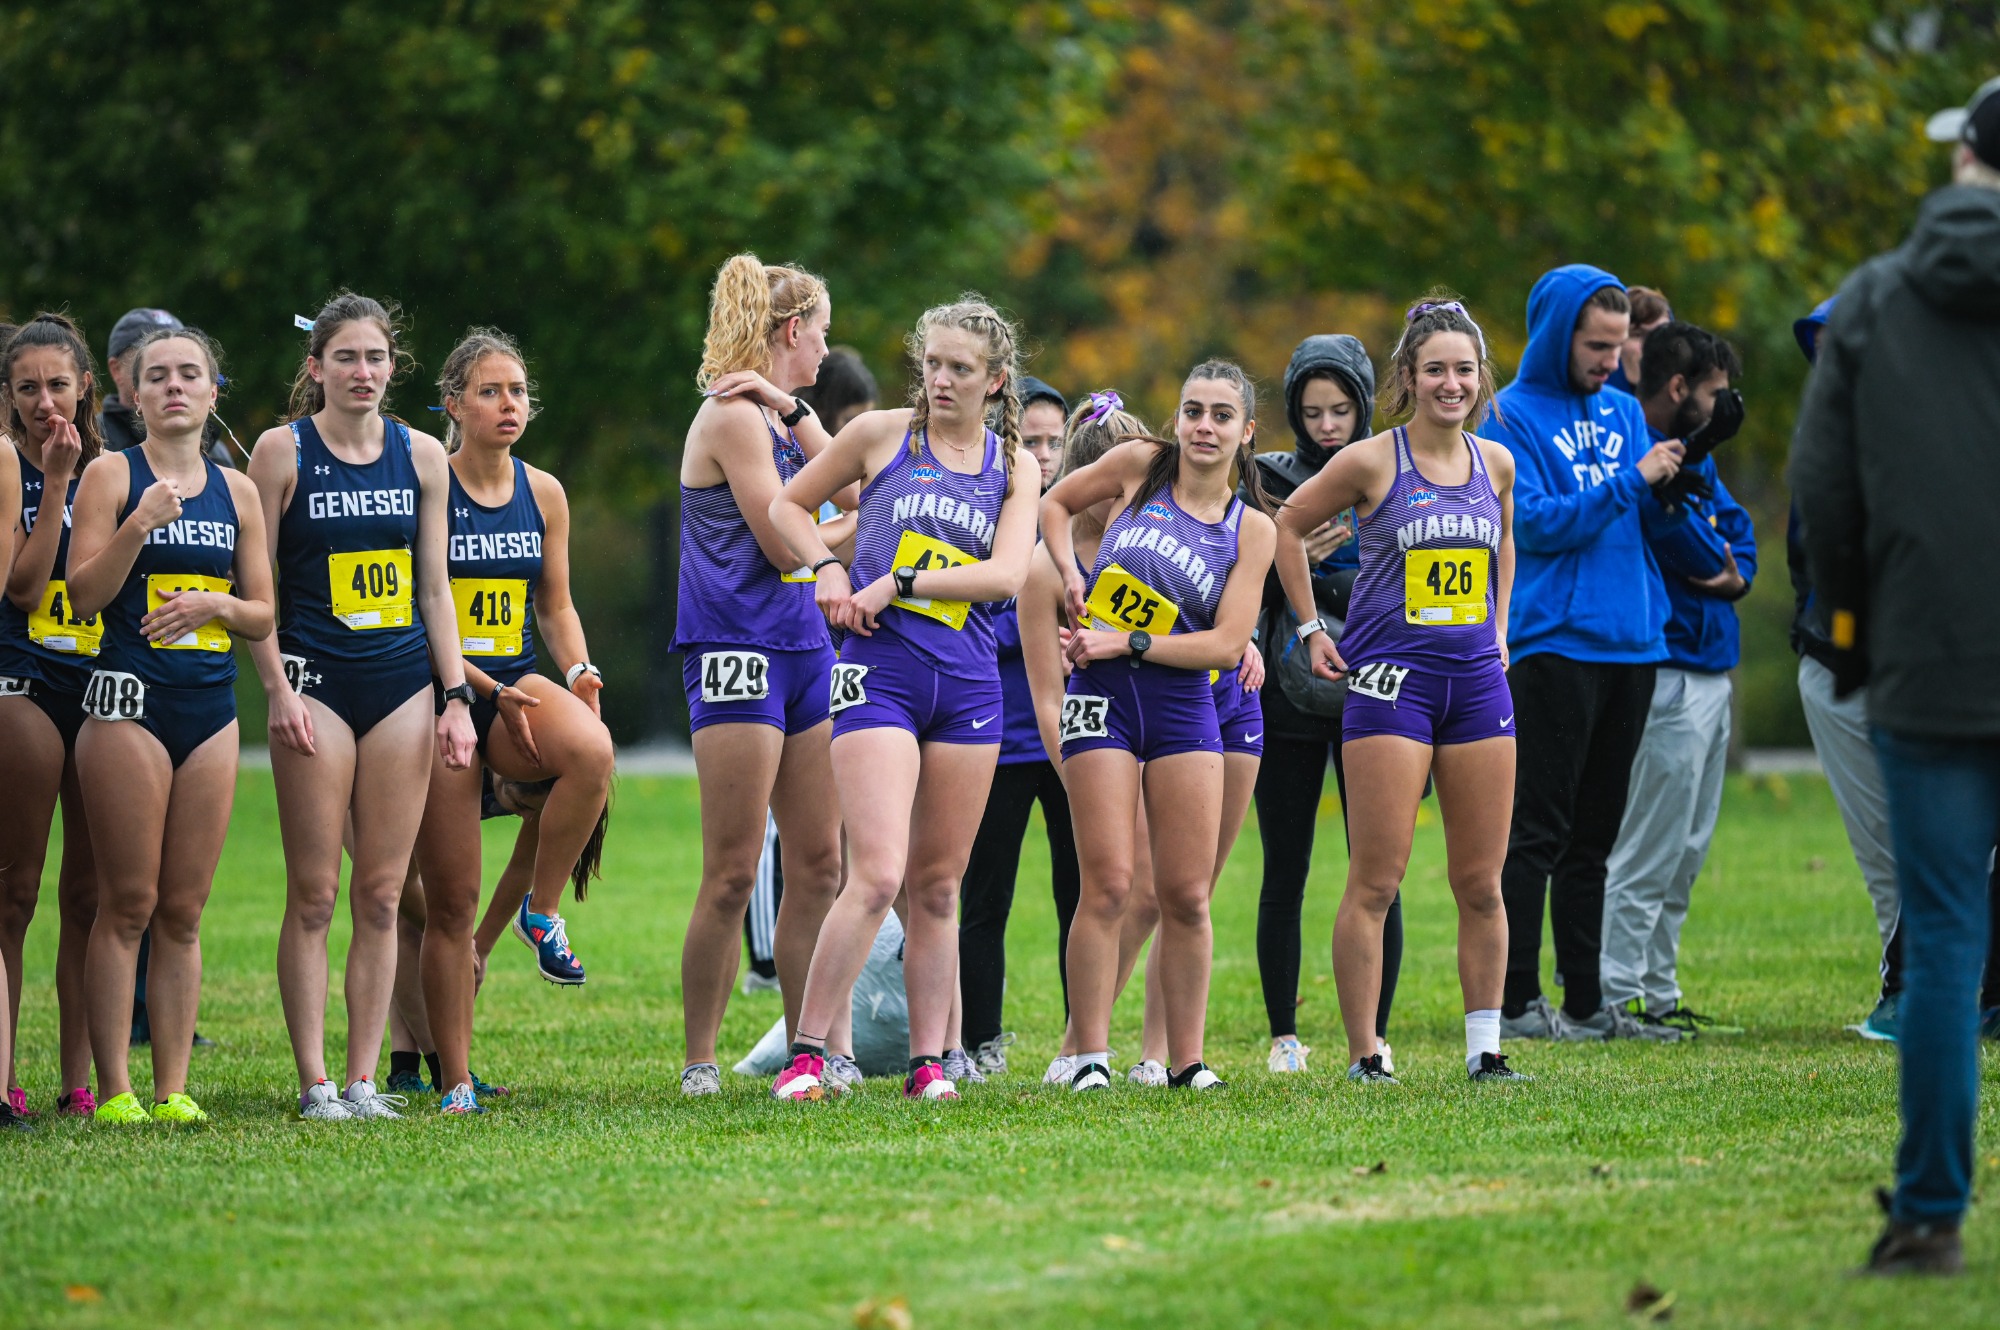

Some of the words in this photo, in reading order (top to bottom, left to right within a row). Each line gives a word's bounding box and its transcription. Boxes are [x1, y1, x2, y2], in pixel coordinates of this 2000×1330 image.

[910, 467, 942, 480] MAAC
[309, 488, 414, 519] GENESEO
[1142, 503, 1174, 521] MAAC
[1406, 490, 1438, 507] MAAC
[143, 520, 236, 551] ENESEO
[891, 493, 996, 552] NIAGARA
[1396, 513, 1500, 554] NIAGARA
[449, 531, 542, 561] GENESEO
[1112, 526, 1216, 603] NIAGARA
[351, 561, 399, 600] 409
[1426, 560, 1473, 596] 426
[469, 590, 512, 626] 418
[1109, 583, 1160, 628] 425
[704, 655, 764, 697] 429
[830, 667, 861, 708] 28
[84, 675, 140, 718] 408
